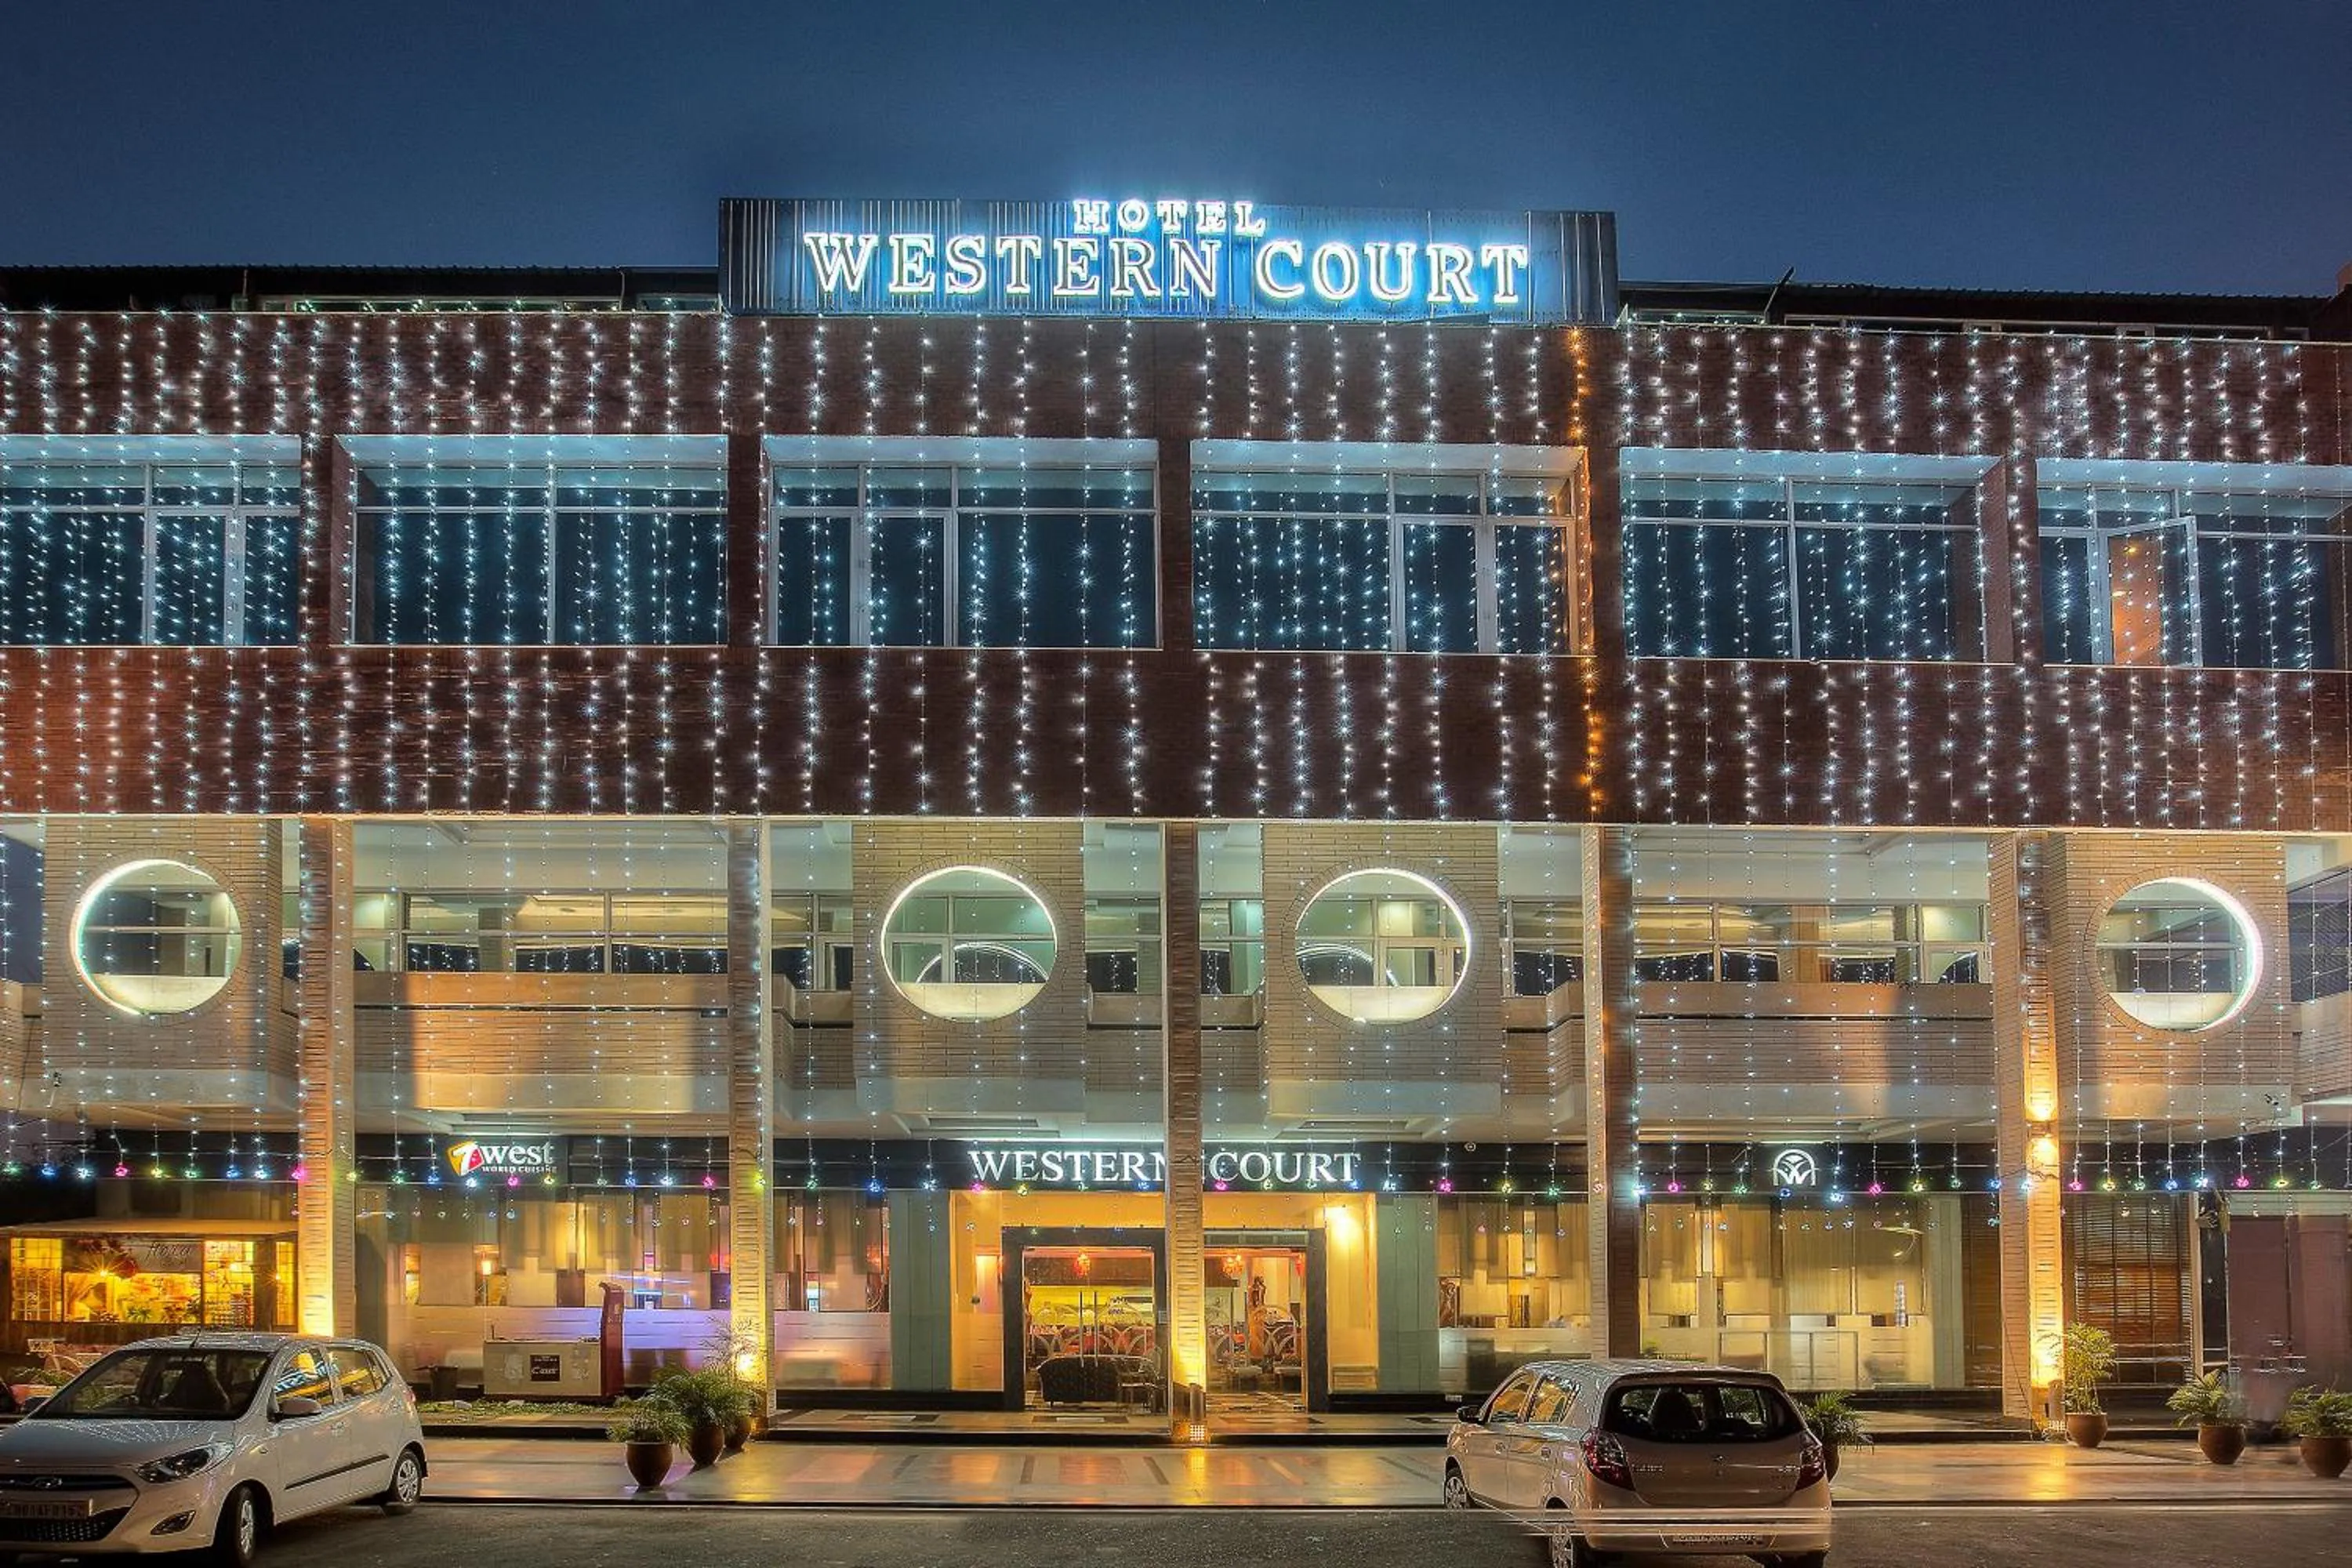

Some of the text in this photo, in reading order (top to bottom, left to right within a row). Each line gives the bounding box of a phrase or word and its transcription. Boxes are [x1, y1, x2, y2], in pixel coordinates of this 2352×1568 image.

[1073, 200, 1267, 237] HOTEL
[804, 233, 1529, 304] WESTERN COURT
[1209, 1152, 1361, 1182] COURT
